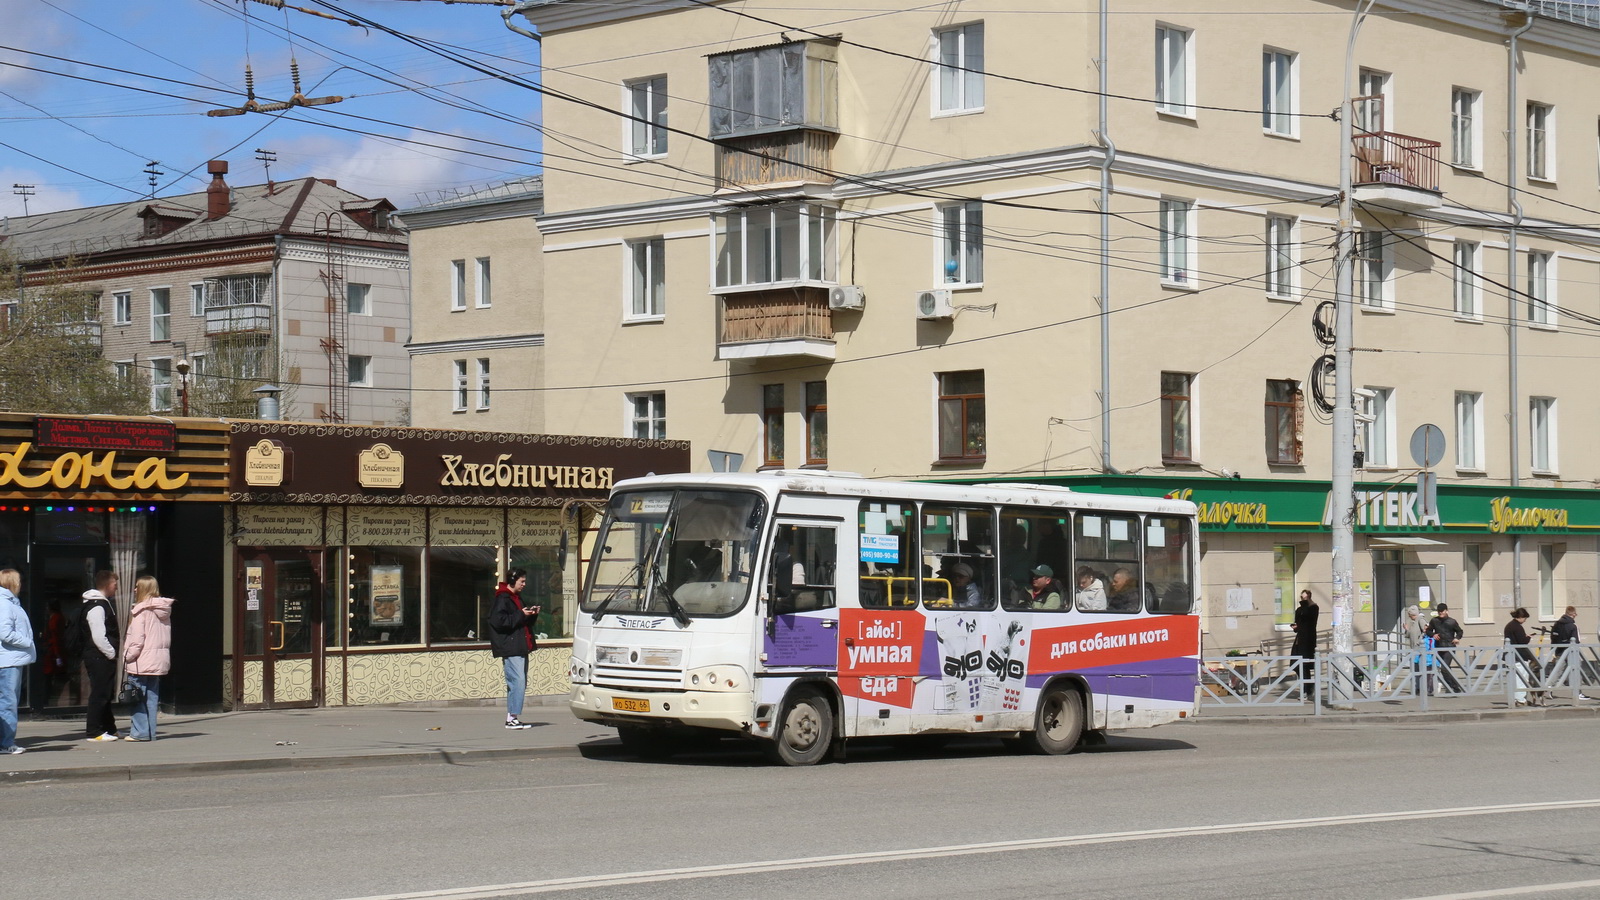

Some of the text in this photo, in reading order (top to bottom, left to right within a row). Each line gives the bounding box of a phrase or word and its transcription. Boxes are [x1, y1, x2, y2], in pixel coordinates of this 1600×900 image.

[115, 425, 147, 437] Острое
[362, 464, 400, 473] Хлебничная
[441, 454, 614, 489] Хлебничная
[631, 499, 643, 511] 72
[253, 514, 276, 526] Пироги
[286, 516, 306, 525] заказ
[1489, 496, 1568, 533] Уралочка
[363, 516, 384, 528] Пироги
[392, 518, 411, 527] заказ
[444, 516, 465, 528] Пироги
[472, 518, 490, 527] заказ
[521, 518, 541, 528] Пироги
[549, 519, 562, 528] зака
[626, 620, 651, 629] ПЕГАС
[1050, 628, 1169, 659] для собаки и кота
[847, 645, 912, 670] умная
[861, 677, 898, 697] еда
[624, 700, 637, 710] 532
